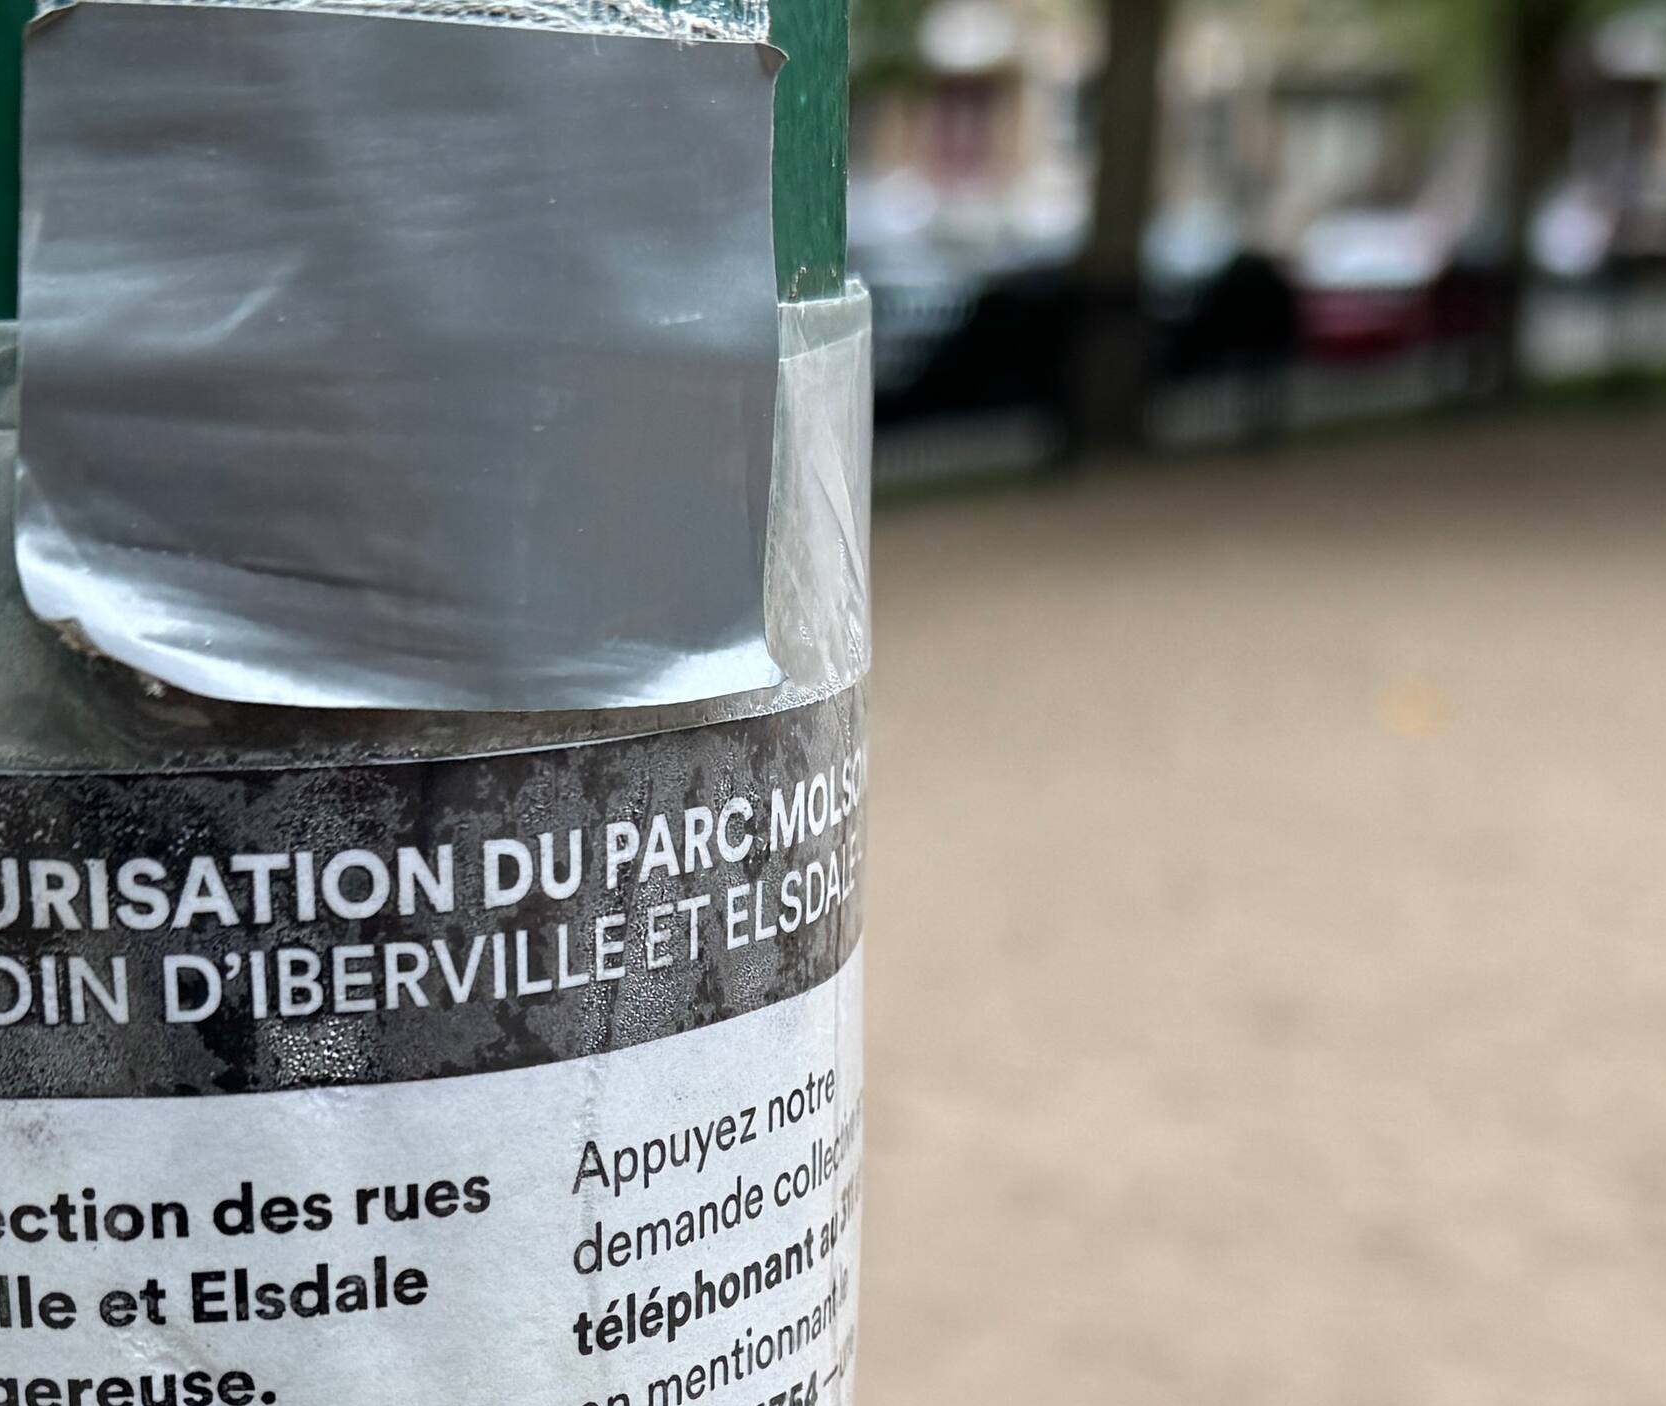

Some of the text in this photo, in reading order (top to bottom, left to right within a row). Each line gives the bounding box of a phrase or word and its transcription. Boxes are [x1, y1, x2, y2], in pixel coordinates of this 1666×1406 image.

[483, 827, 583, 912] DU
[603, 796, 754, 892] PARC
[770, 749, 867, 852] MOLSO
[166, 914, 625, 1025] D'IBERVILLE
[646, 894, 712, 973] ET
[727, 832, 855, 950] ELSDALE
[571, 1068, 835, 1198] Appuyez notre
[213, 1182, 332, 1236] des
[355, 1173, 491, 1228] rues
[573, 1175, 763, 1275] demande
[99, 1278, 167, 1328] et
[190, 1256, 429, 1325] Elsdale
[573, 1227, 814, 1357] téléphonant
